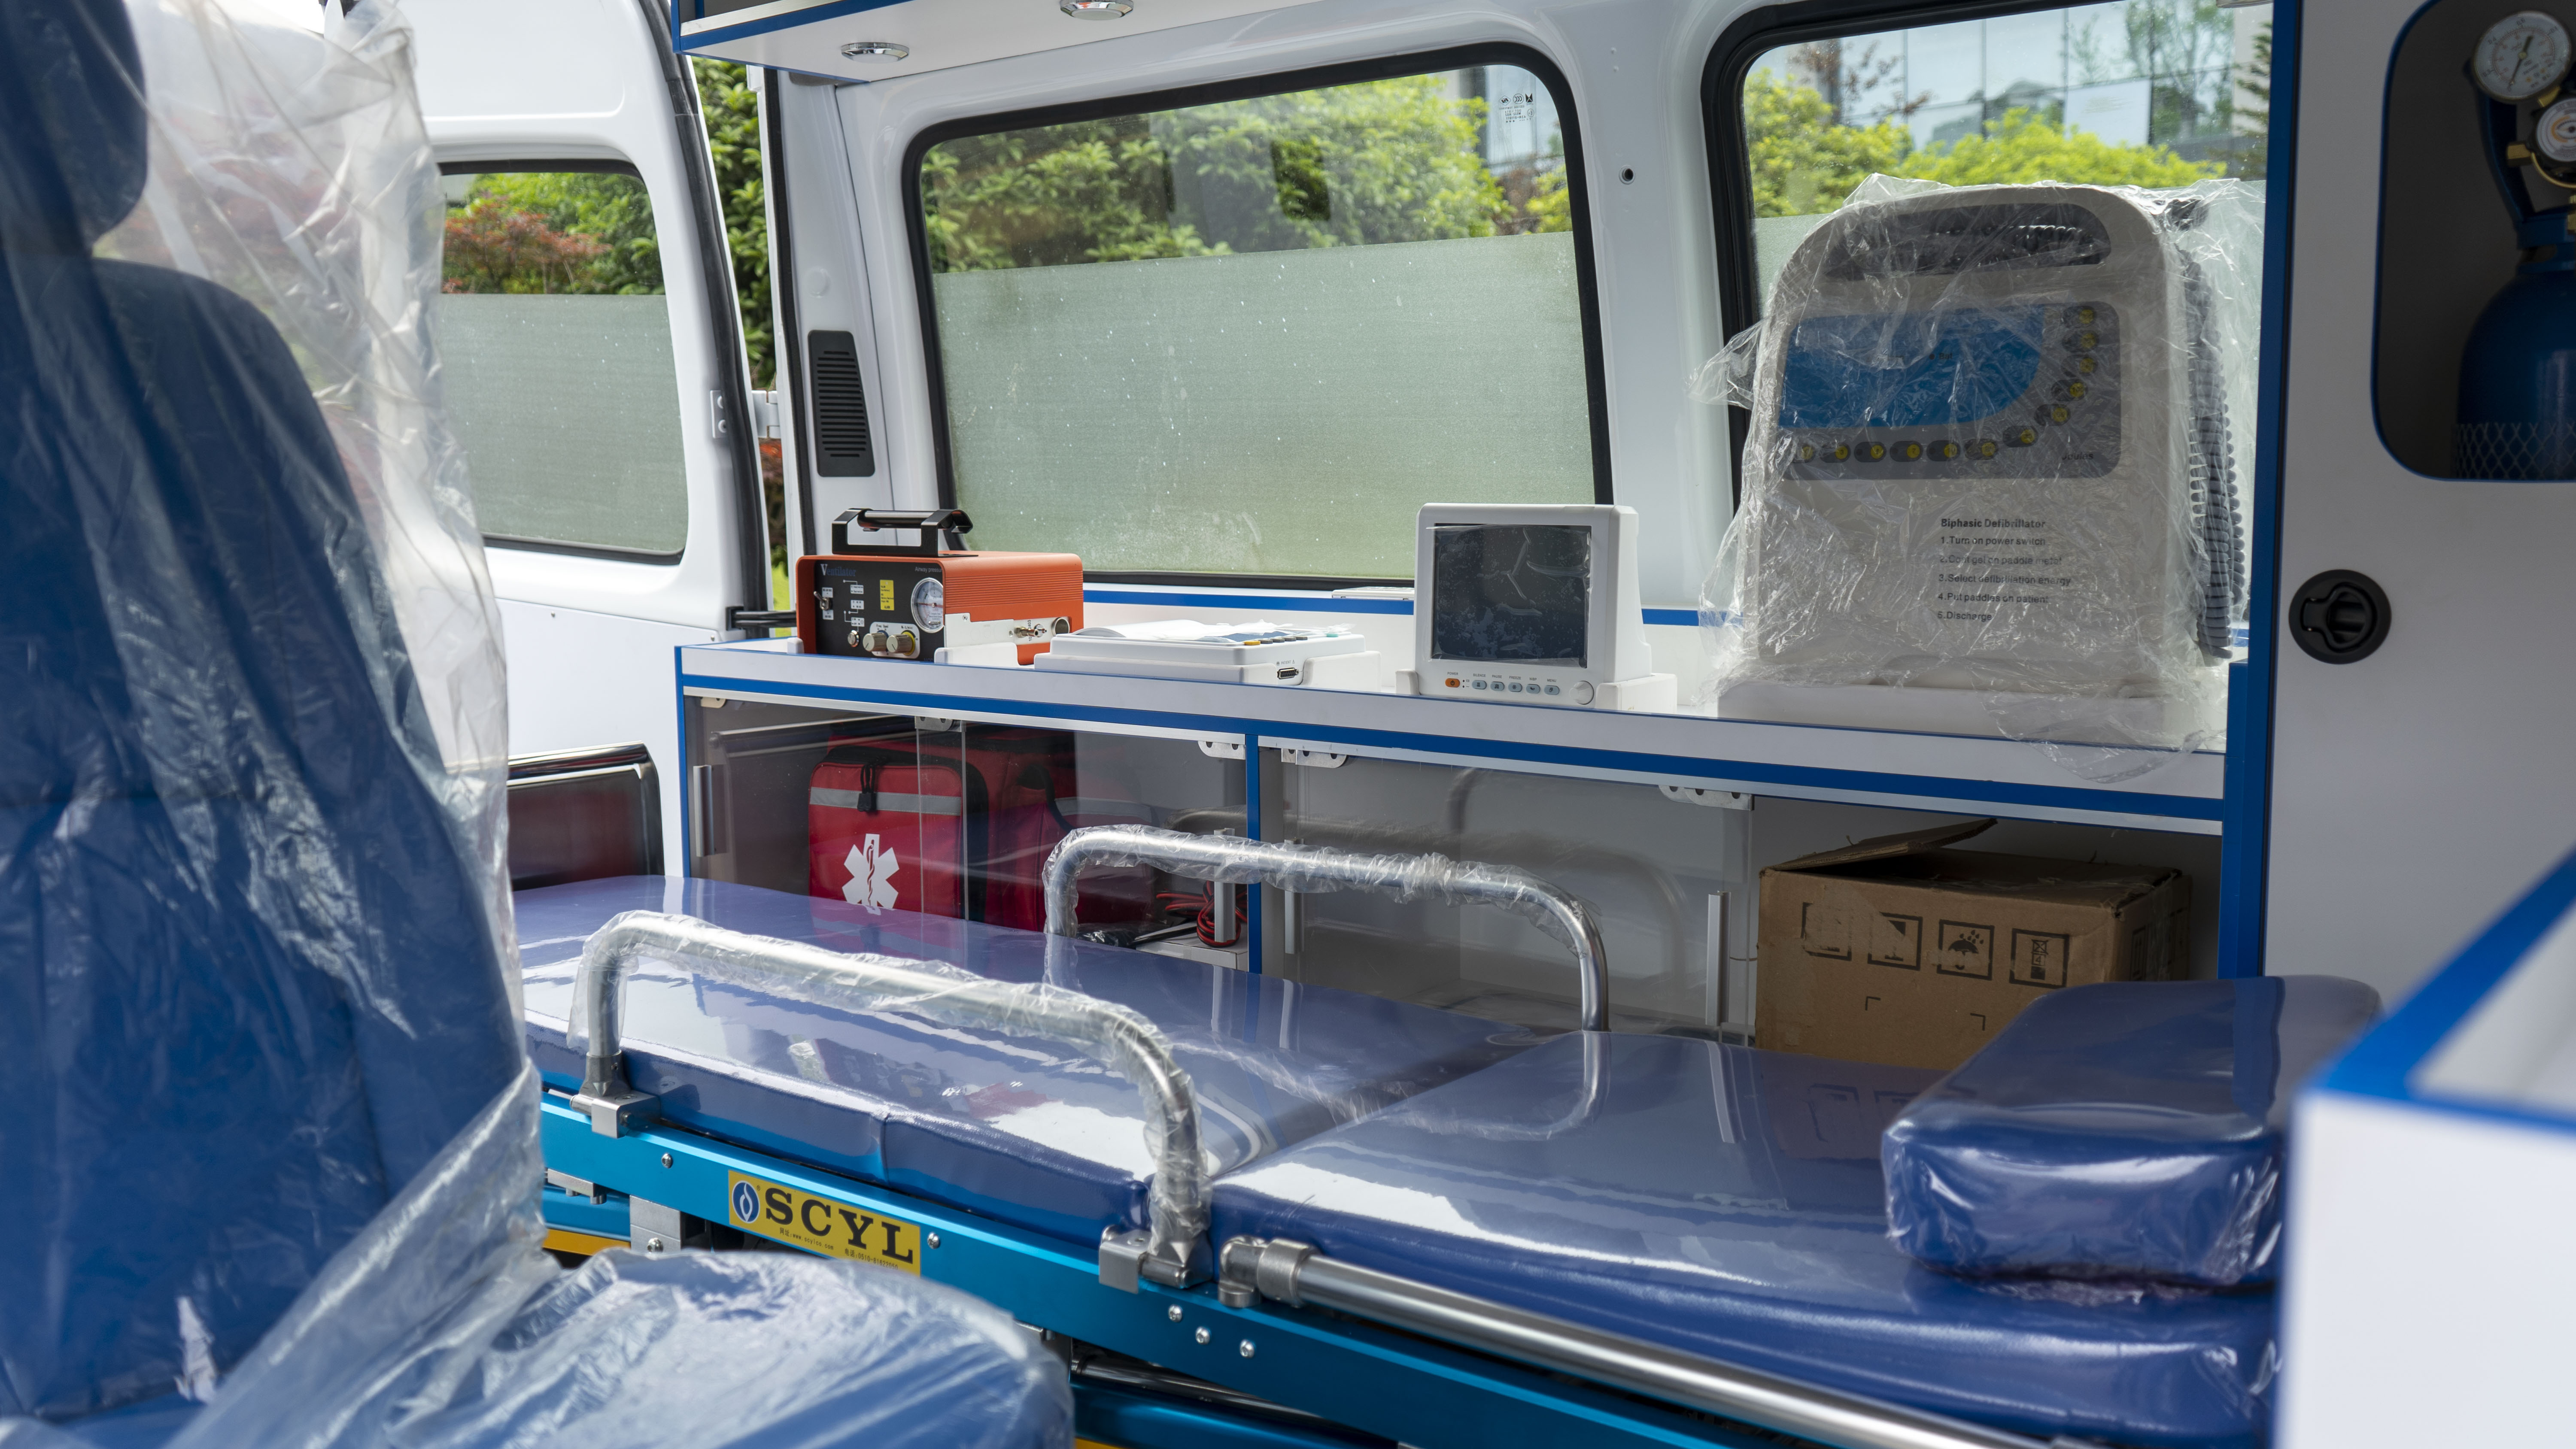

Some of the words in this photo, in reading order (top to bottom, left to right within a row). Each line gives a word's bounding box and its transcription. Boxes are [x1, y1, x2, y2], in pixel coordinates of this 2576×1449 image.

[2062, 452, 2094, 460] Joules
[1941, 518, 1982, 528] Biphasic
[1984, 518, 2045, 528] Defibrillator
[2016, 537, 2045, 546] switch
[1971, 556, 1986, 565] gel
[2002, 557, 2033, 566] paddle
[820, 564, 857, 576] Ventilator
[2038, 578, 2071, 586] energy
[1964, 594, 2000, 603] paddles
[2016, 595, 2049, 603] patient
[765, 1188, 913, 1264] SCYL
